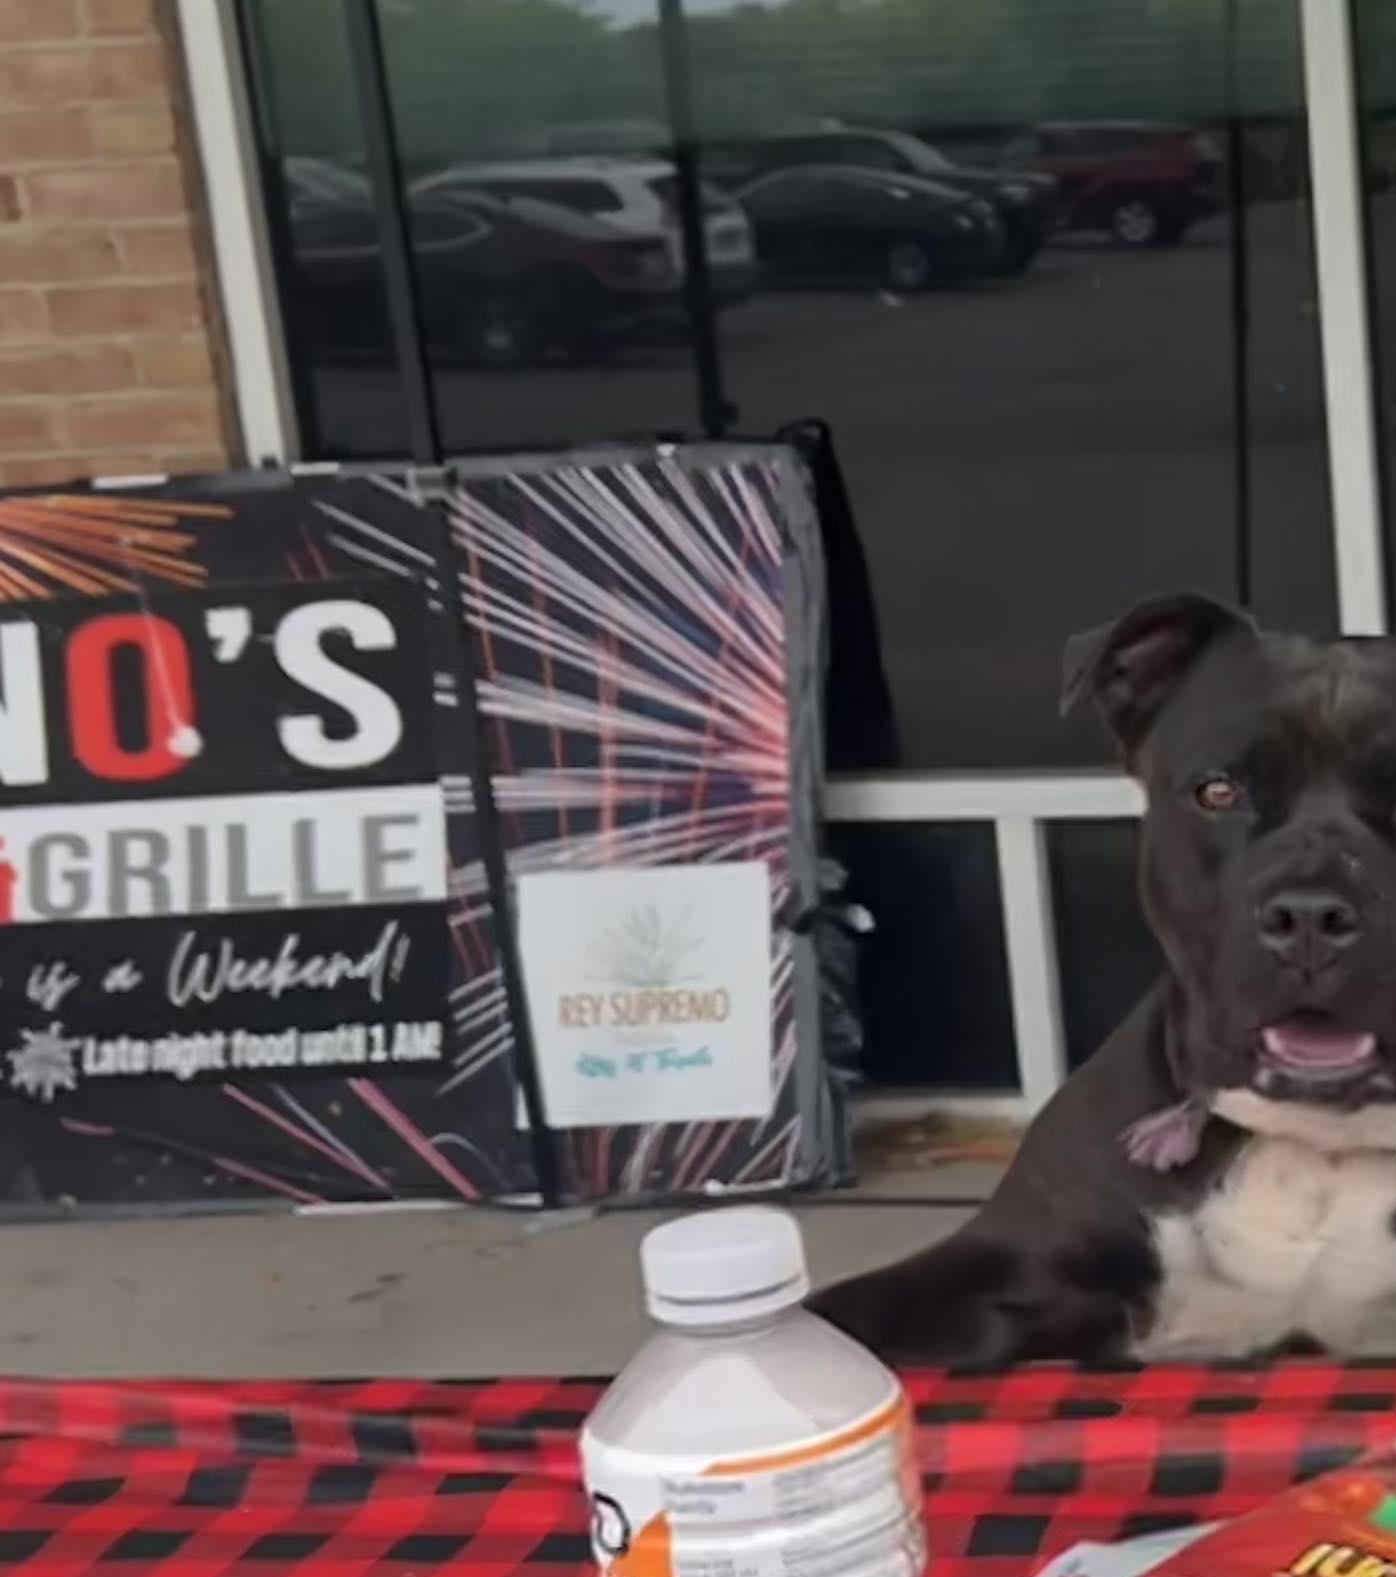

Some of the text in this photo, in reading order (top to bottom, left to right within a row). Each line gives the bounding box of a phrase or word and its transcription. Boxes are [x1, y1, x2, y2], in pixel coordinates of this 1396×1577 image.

[27, 813, 423, 920] GRILLE
[26, 919, 411, 1012] is a Weekend!
[558, 986, 732, 1029] REY SUPREMO
[82, 1034, 149, 1077] Late
[151, 1030, 227, 1081] night
[230, 1027, 299, 1068] food
[300, 1022, 367, 1066] until
[369, 1022, 388, 1062] 1
